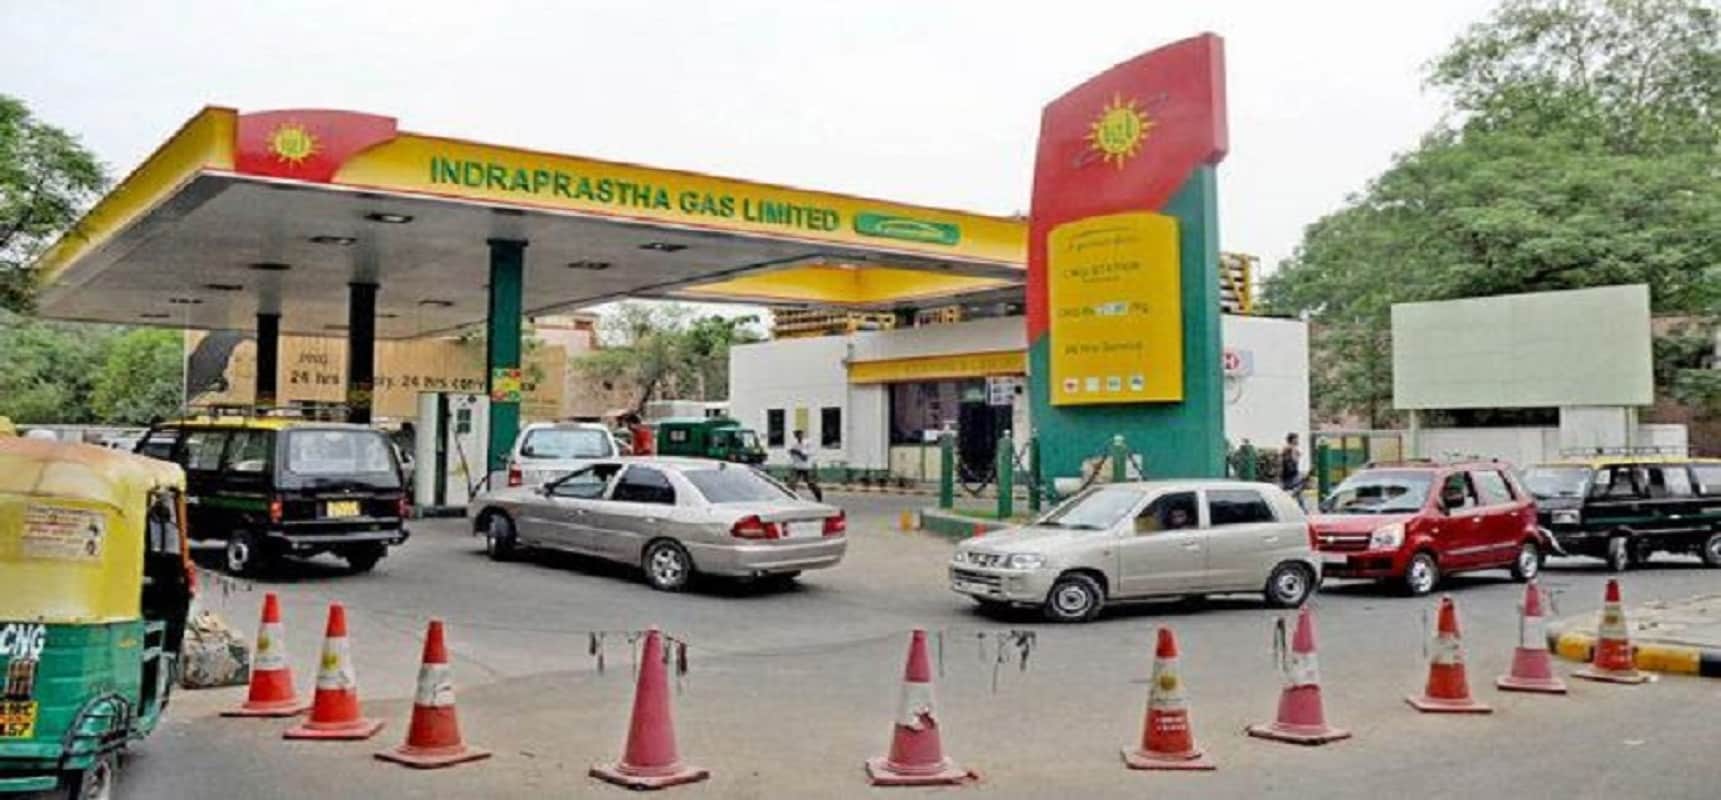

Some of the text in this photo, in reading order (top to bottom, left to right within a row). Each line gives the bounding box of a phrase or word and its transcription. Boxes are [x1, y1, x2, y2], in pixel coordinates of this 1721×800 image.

[430, 155, 670, 211] INDRAPRASTHA
[679, 191, 735, 218] GAS
[743, 197, 841, 231] LIMITED
[0, 623, 47, 662] CNG
